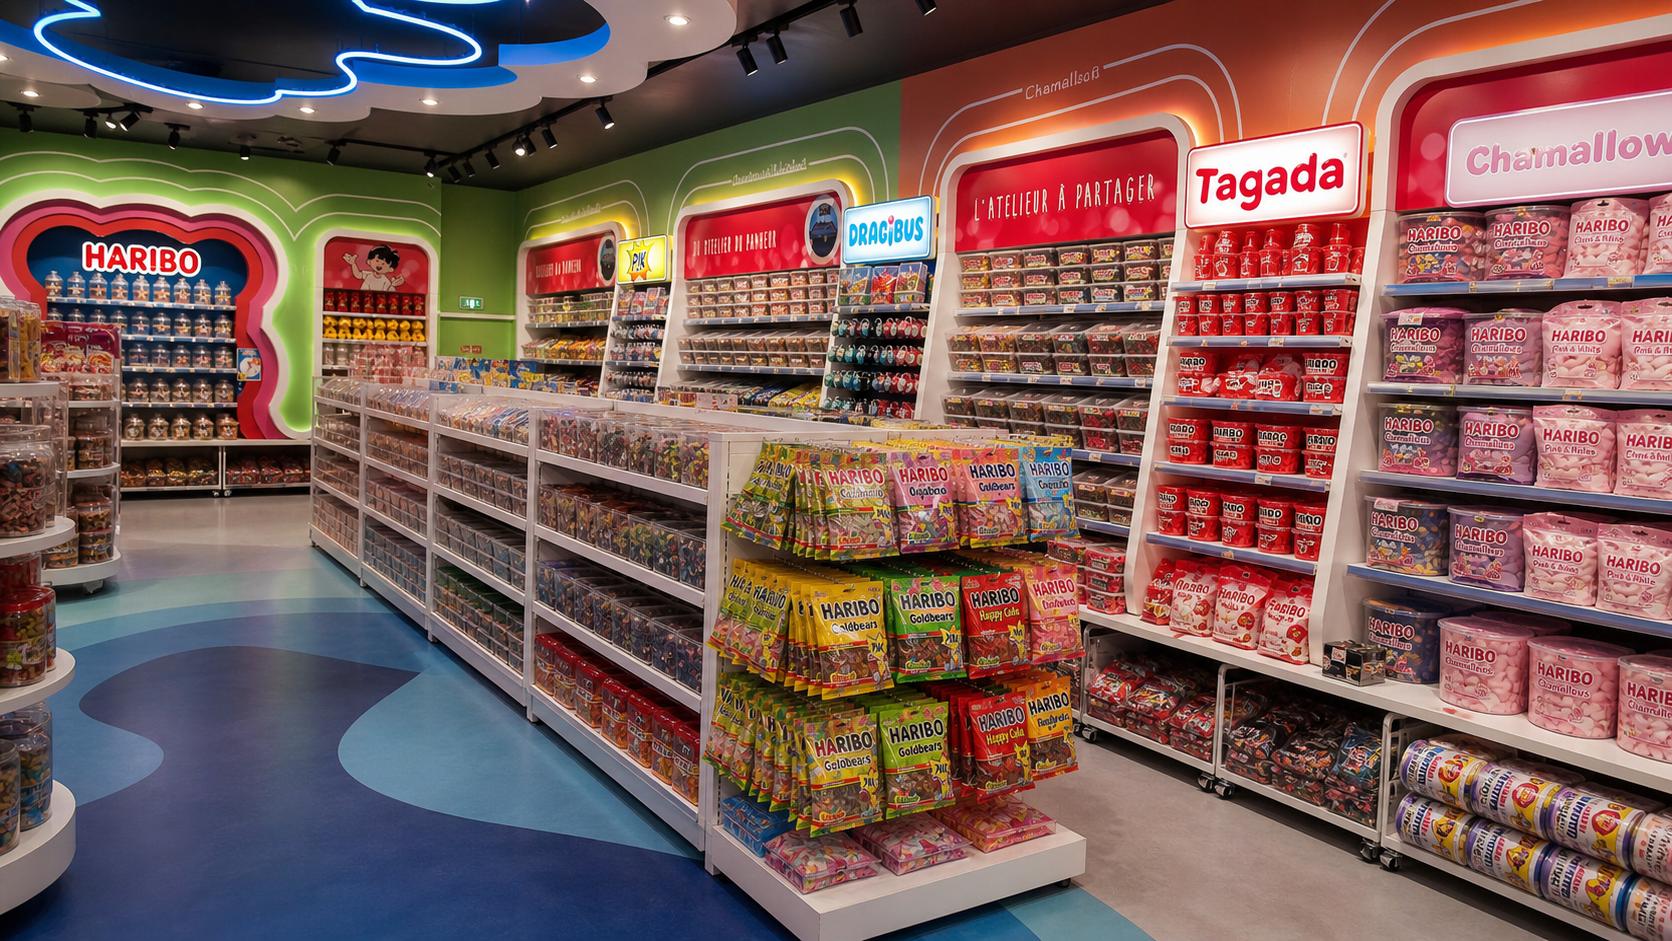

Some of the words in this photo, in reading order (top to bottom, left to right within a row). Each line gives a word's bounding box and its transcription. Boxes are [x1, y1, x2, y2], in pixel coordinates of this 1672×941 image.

[1075, 173, 1155, 209] PARTAGER
[1195, 152, 1344, 211] Tagada
[848, 215, 924, 247] DRAGIBUS
[1407, 226, 1461, 242] HARIBO
[1494, 221, 1550, 238] HARIBO
[1575, 218, 1629, 234] HARIBO
[83, 243, 200, 275] HARIBO
[1390, 327, 1441, 342] HARIBO
[1471, 327, 1527, 342] HARIBO
[1551, 329, 1607, 343] HARIBO
[1632, 329, 1672, 343] HARI
[1384, 417, 1434, 433] HARIBO
[1464, 421, 1519, 439] HARIBO
[1543, 428, 1600, 445] HARIBO
[828, 468, 884, 486] HARIBO
[898, 466, 948, 483] HARIBO
[969, 463, 1016, 479] HARIBO
[1030, 461, 1070, 476] HARIBO
[1371, 511, 1418, 531] HARIBO
[1455, 524, 1508, 544] HARIBO
[1532, 545, 1583, 563] HARIBO
[1606, 555, 1661, 575] HARIBO
[1033, 578, 1075, 597] HARIBO
[900, 591, 956, 610] HARIBO
[971, 587, 1020, 609] HARIBO
[820, 599, 880, 620] HARIBO
[1445, 640, 1497, 664] HARIBO
[1537, 661, 1593, 686] HARIBO
[1028, 692, 1069, 716] HARIBO
[978, 706, 1025, 732] HARIBO
[889, 719, 944, 744] HARIBO
[815, 731, 873, 758] HARIBO
